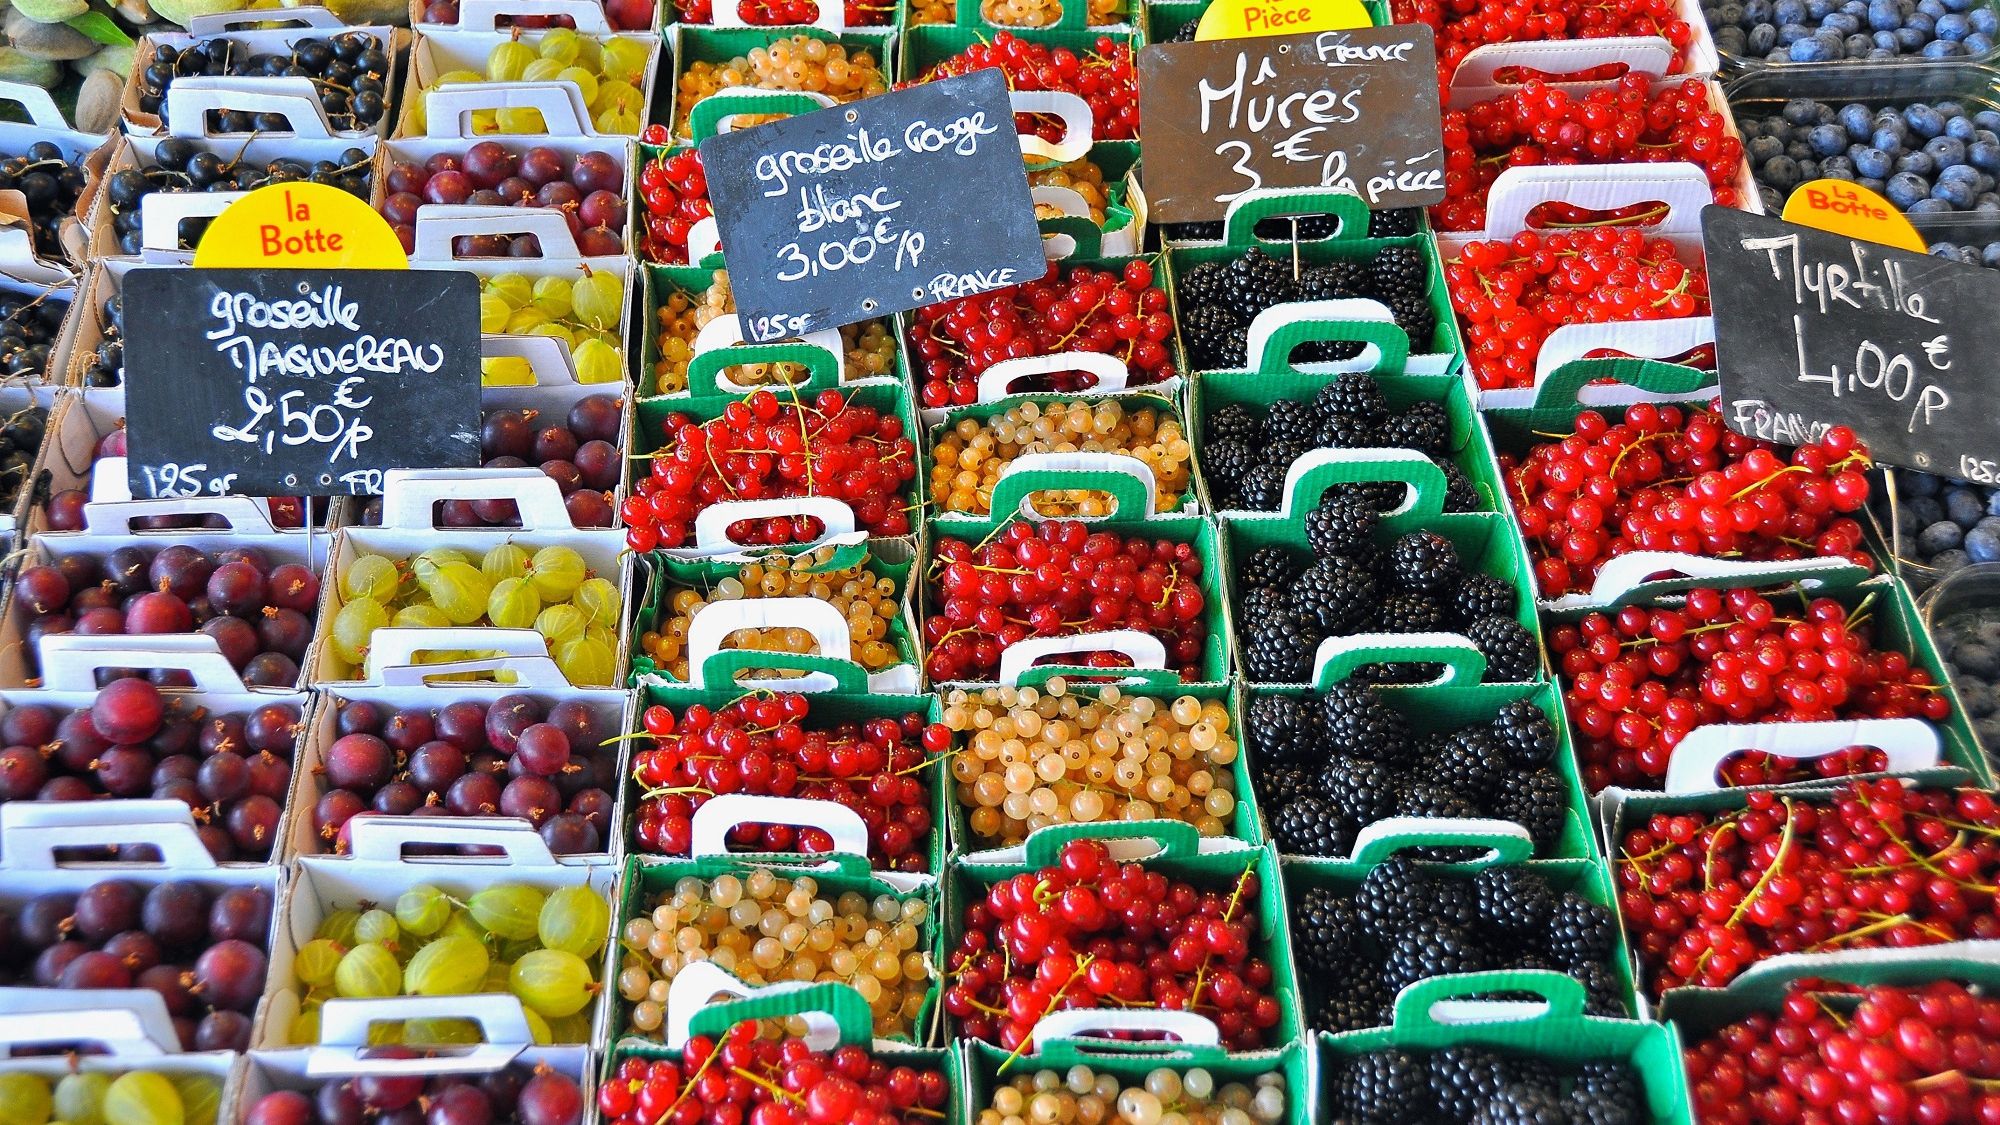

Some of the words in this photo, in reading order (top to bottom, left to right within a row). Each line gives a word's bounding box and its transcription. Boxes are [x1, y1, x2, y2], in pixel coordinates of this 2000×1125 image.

[1244, 7, 1311, 32] Pièce
[1315, 31, 1414, 63] France
[1198, 52, 1361, 134] Mûres
[755, 127, 902, 198] groseille
[284, 190, 310, 223] la
[796, 184, 902, 233] blanc
[1806, 189, 1889, 222] Botte
[1832, 186, 1859, 201] La
[260, 225, 343, 257] Botte
[928, 268, 1017, 302] FRANCE
[206, 284, 360, 341] groseille
[217, 334, 445, 382] MAQUEREAU
[144, 463, 207, 497] 125
